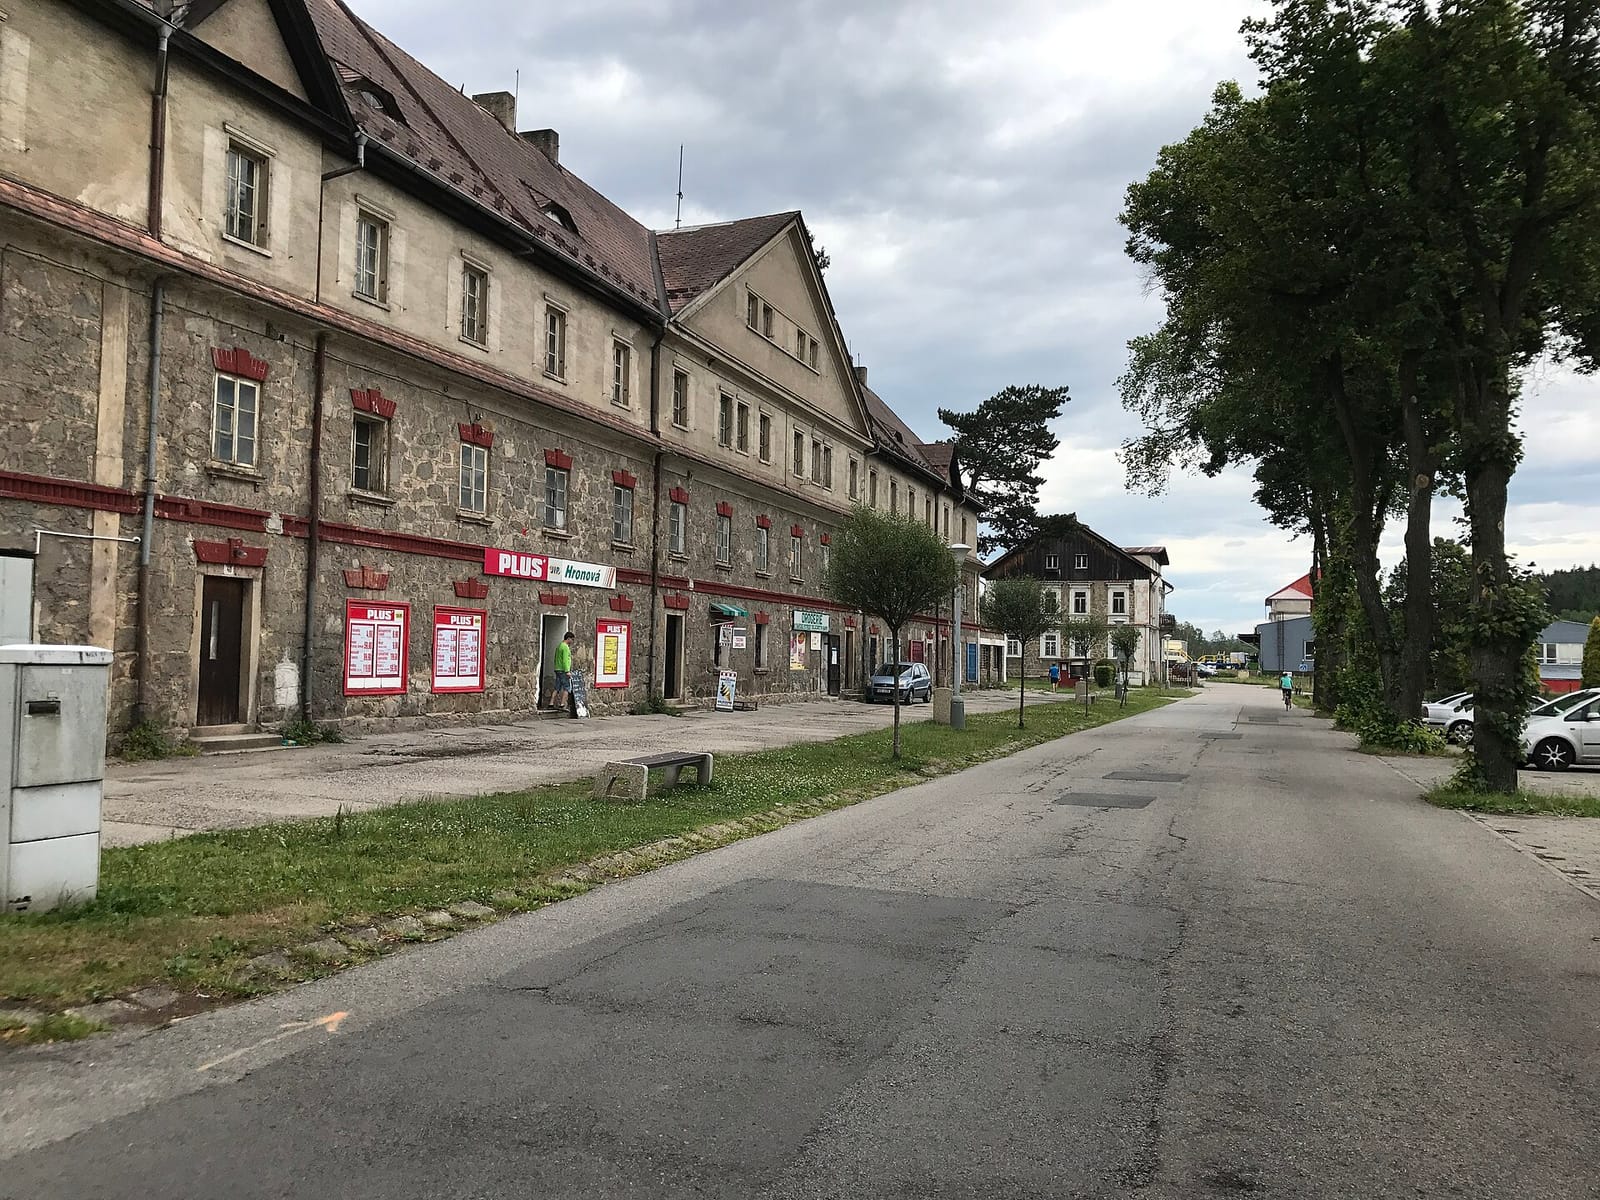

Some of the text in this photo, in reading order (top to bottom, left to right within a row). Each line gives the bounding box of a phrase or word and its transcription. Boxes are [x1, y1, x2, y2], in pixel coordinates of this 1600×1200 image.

[498, 553, 544, 578] PLUS
[564, 564, 601, 582] Hronová
[367, 609, 392, 620] PLUS
[450, 615, 472, 625] PLUS
